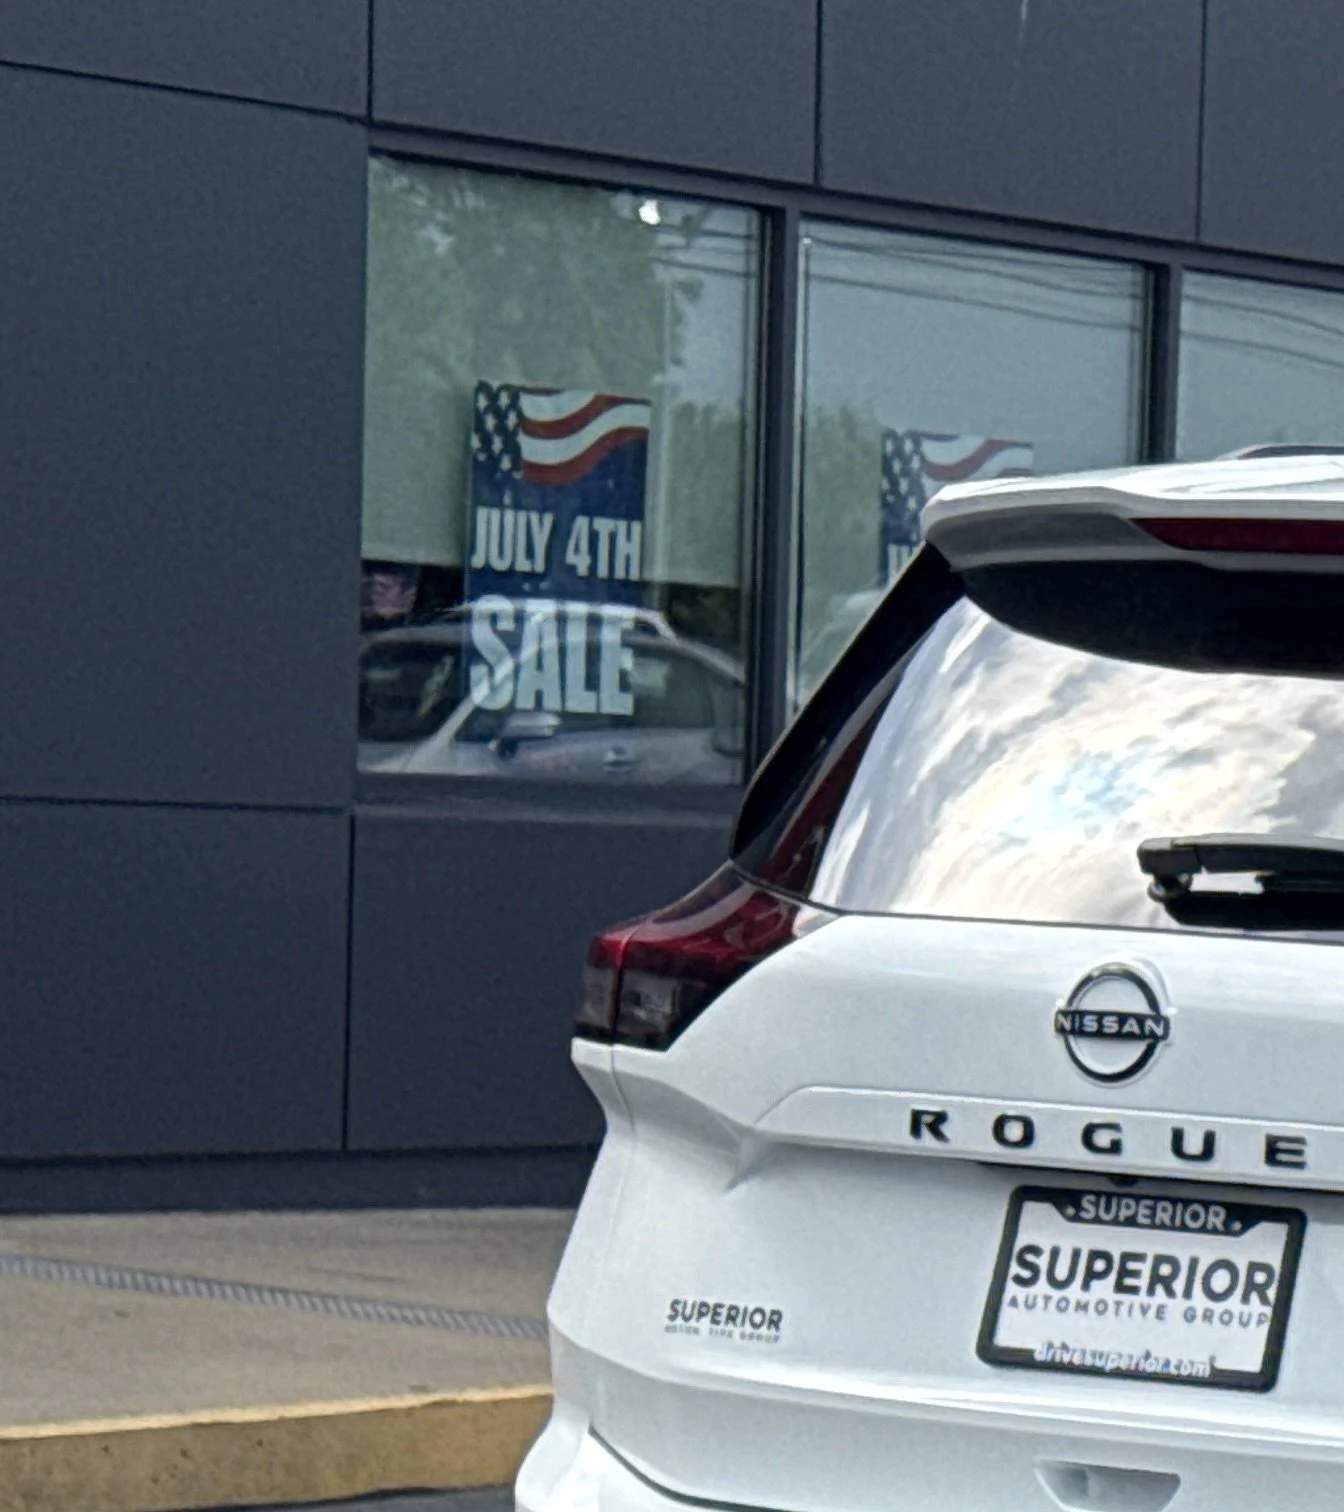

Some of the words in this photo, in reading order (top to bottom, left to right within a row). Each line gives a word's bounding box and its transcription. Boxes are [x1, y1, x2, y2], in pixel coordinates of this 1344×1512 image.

[470, 505, 554, 574] JULY
[565, 515, 643, 581] 4TH
[469, 594, 636, 716] SALE
[1056, 1012, 1165, 1037] NISSAN
[909, 1108, 1309, 1170] ROGUE
[1078, 1193, 1228, 1232] SUPERIOR
[1011, 1243, 1277, 1307] SUPERIOR
[666, 1298, 784, 1333] SUPERIOR
[1006, 1294, 1169, 1322] AUTOMOTIVE
[1182, 1306, 1272, 1329] GROUP
